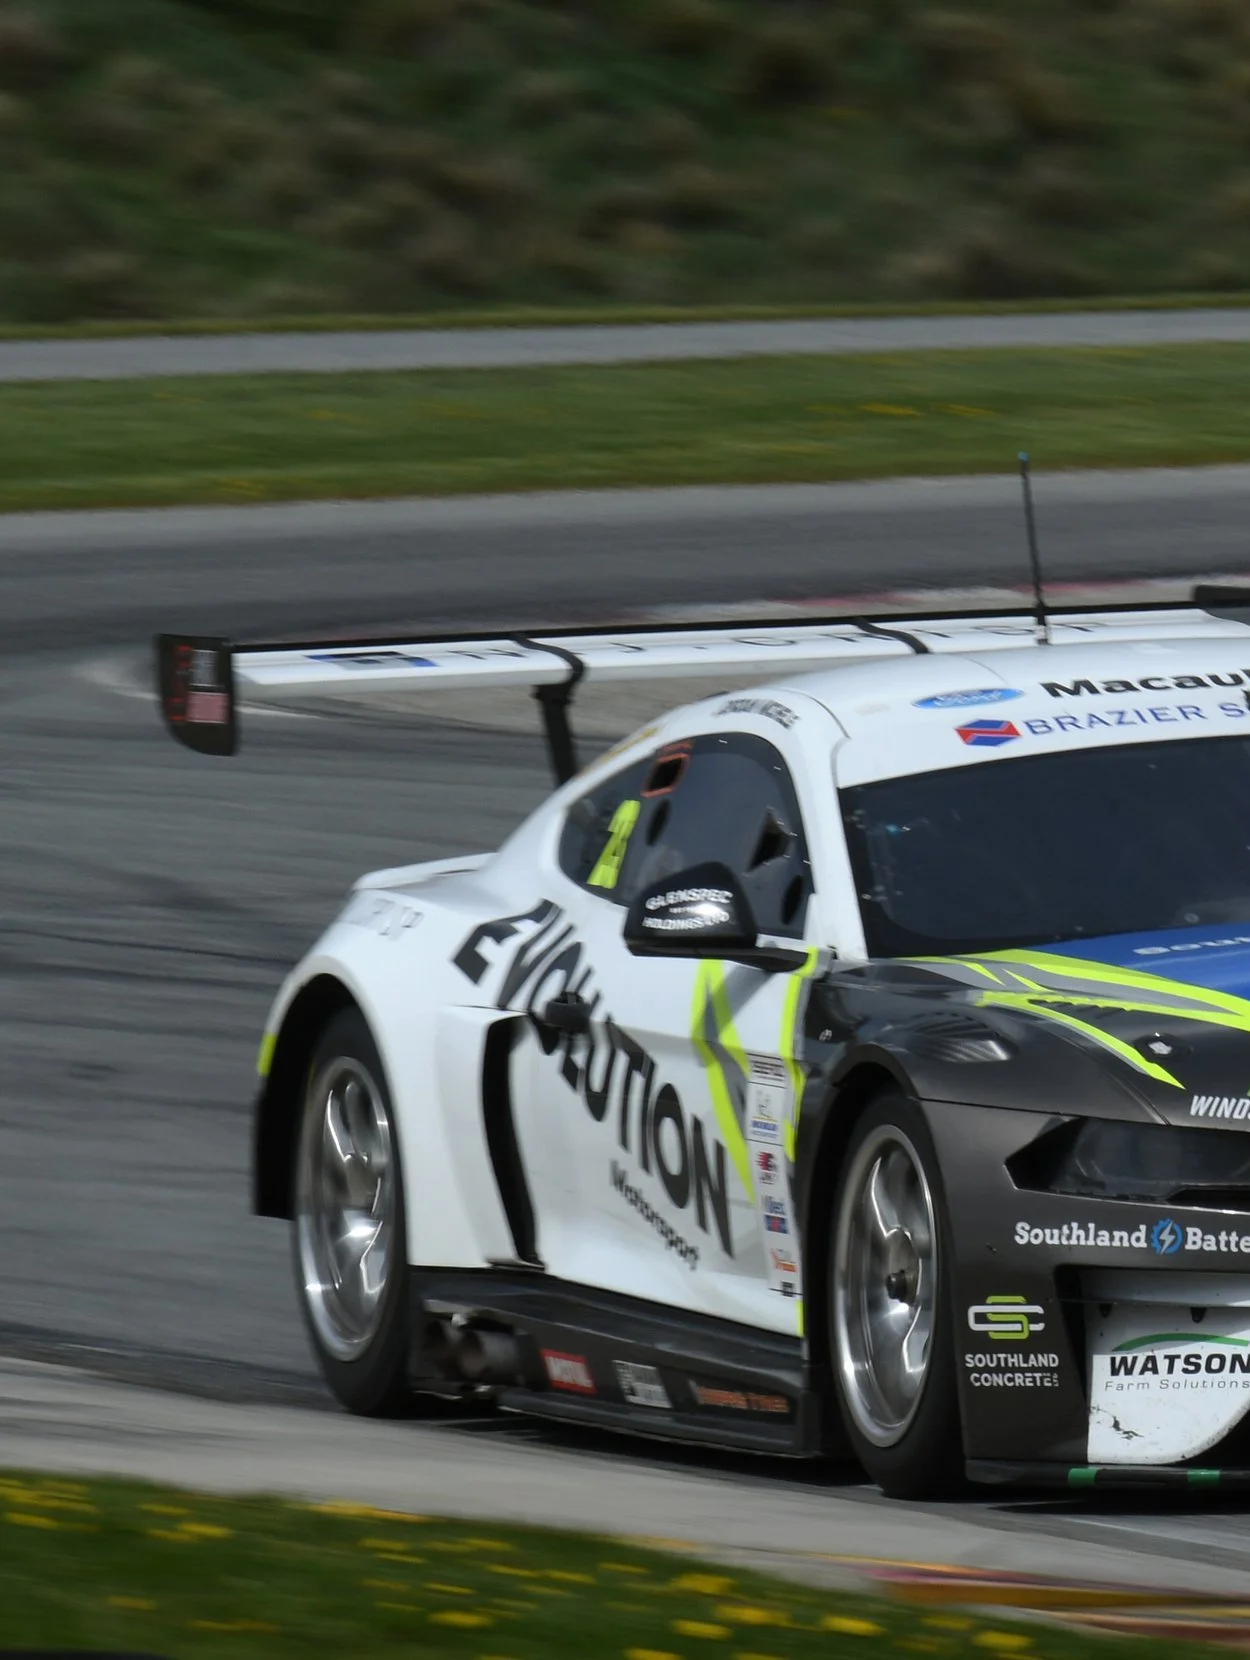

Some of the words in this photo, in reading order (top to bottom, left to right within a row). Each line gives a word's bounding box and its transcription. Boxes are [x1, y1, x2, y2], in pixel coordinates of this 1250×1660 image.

[1023, 704, 1207, 736] BRAZIER
[645, 887, 734, 911] GLENSPEC
[641, 916, 704, 930] HOLDINGS
[1014, 1221, 1148, 1249] Southland
[965, 1352, 1060, 1369] SOUTHLAND
[969, 1371, 1051, 1388] CONCRETE
[1104, 1379, 1151, 1392] Farm
